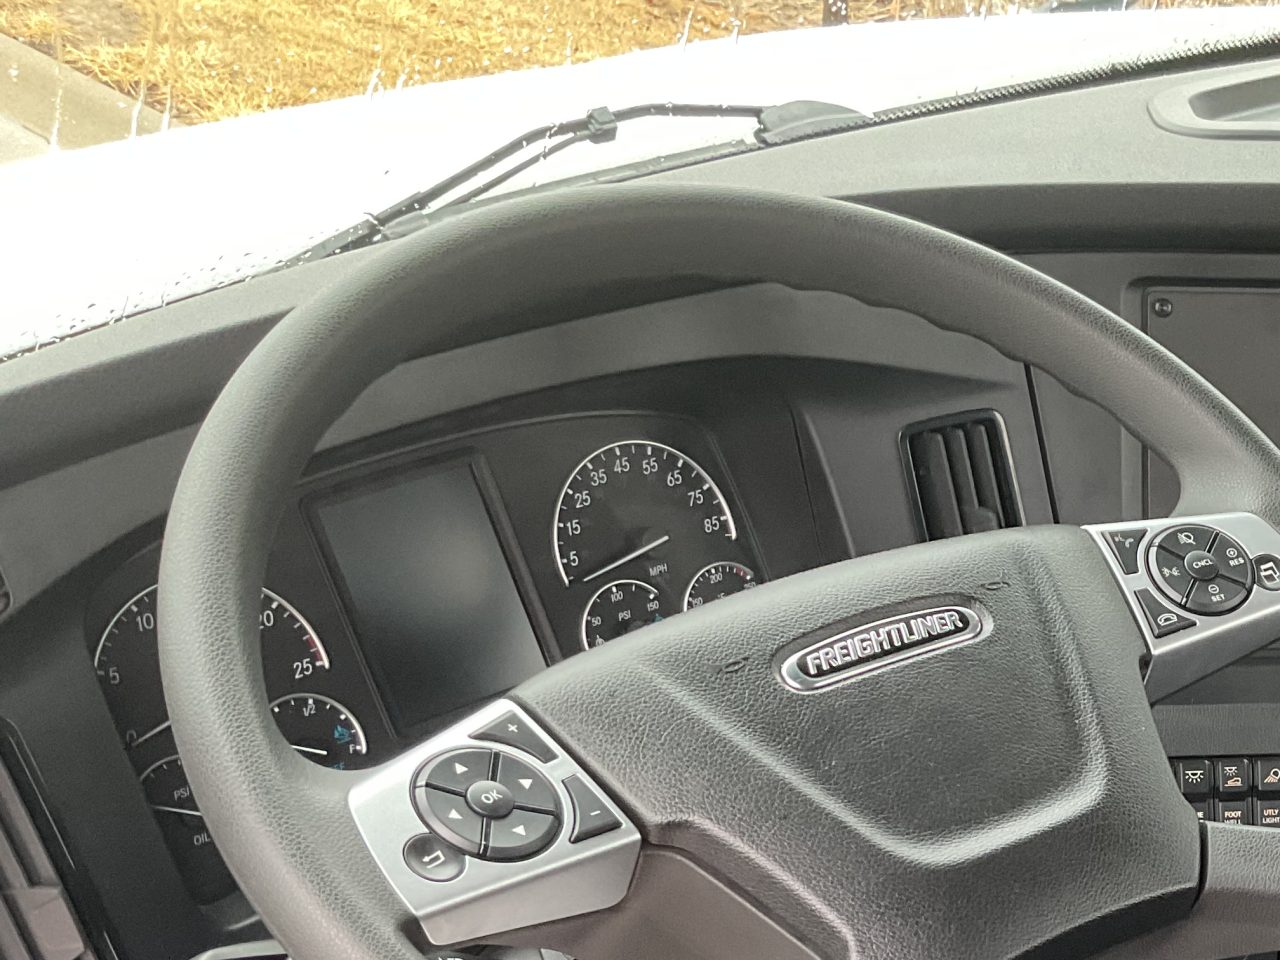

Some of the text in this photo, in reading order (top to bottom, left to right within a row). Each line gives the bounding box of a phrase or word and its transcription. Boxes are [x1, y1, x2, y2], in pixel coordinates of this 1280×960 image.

[614, 457, 630, 473] 45
[643, 458, 658, 474] 55
[591, 469, 607, 486] 35
[667, 470, 682, 486] 65
[575, 491, 590, 508] 25
[688, 490, 703, 507] 75
[566, 520, 581, 536] 15
[704, 516, 719, 533] 85
[570, 551, 578, 566] 5
[1193, 559, 1213, 568] CNCL
[1229, 558, 1245, 566] RES
[650, 563, 668, 577] MPH
[710, 573, 723, 584] 200
[611, 592, 623, 603] 100
[1211, 594, 1225, 602] SET
[648, 601, 660, 612] 150
[136, 613, 154, 632] 10
[592, 617, 602, 626] 50
[619, 610, 631, 621] PSI
[806, 611, 963, 675] FREIGHTLINER
[109, 667, 120, 684] 5
[294, 658, 312, 679] 25
[174, 787, 190, 800] PSI
[481, 790, 503, 804] OK
[194, 834, 210, 846] OIL
